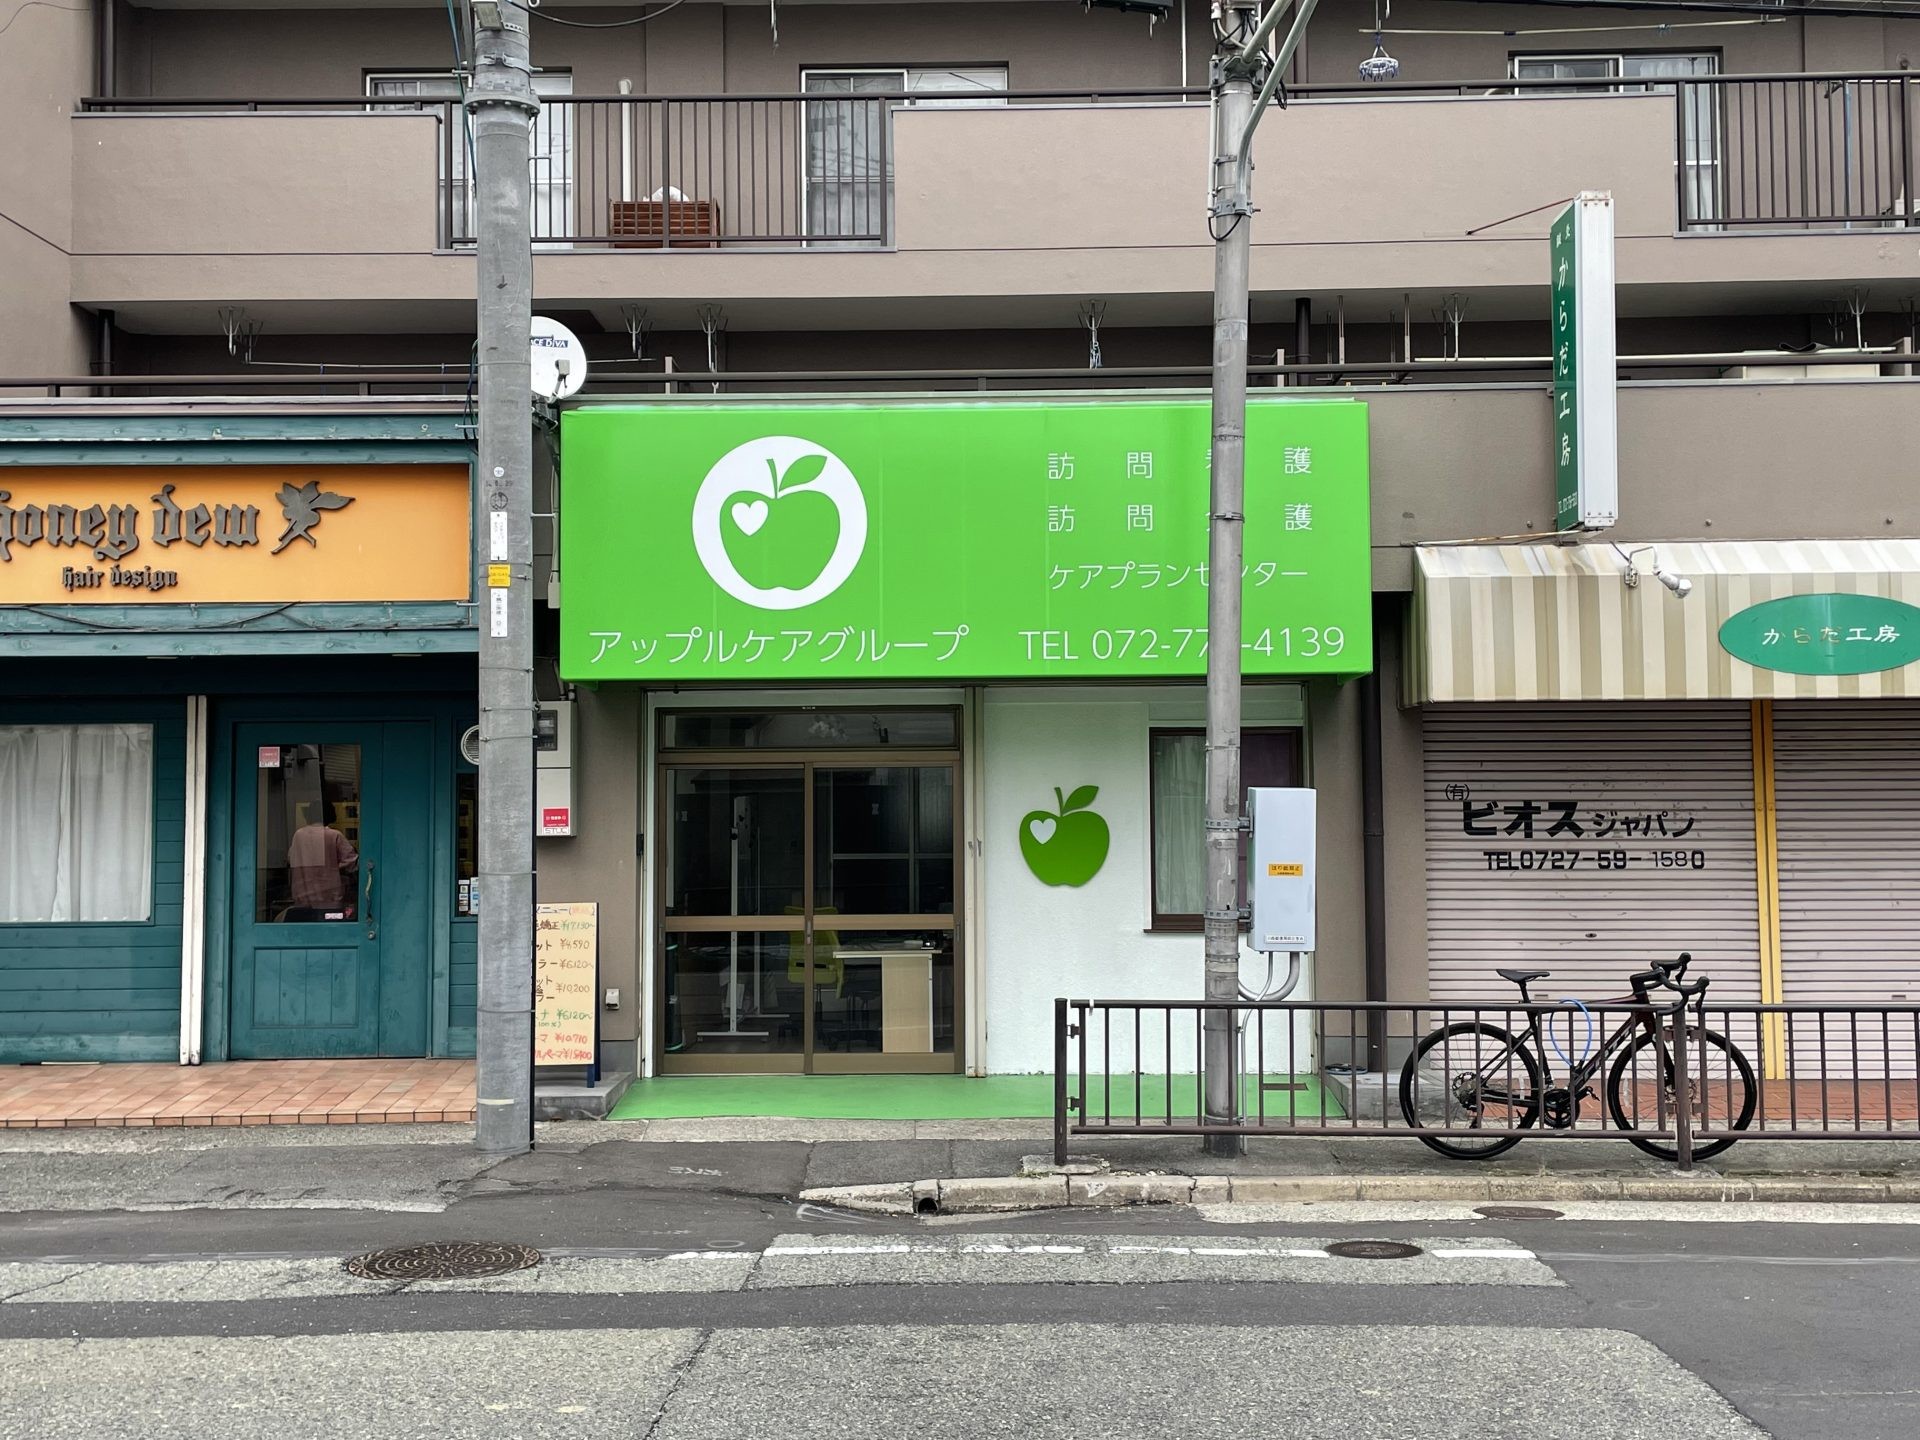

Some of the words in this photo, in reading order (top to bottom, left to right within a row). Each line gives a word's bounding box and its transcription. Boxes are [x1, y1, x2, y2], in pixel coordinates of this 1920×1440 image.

[1557, 256, 1571, 466] からだ工房
[1047, 447, 1313, 480] 訪問護
[150, 483, 260, 547] dew
[1047, 503, 1313, 532] 訪問護
[62, 565, 103, 592] hair
[110, 563, 177, 591] design
[589, 624, 970, 664] アップルケアグループ
[1018, 631, 1079, 660] TEL
[1091, 627, 1345, 659] 072-77-4139
[1762, 623, 1901, 645] からだ工房
